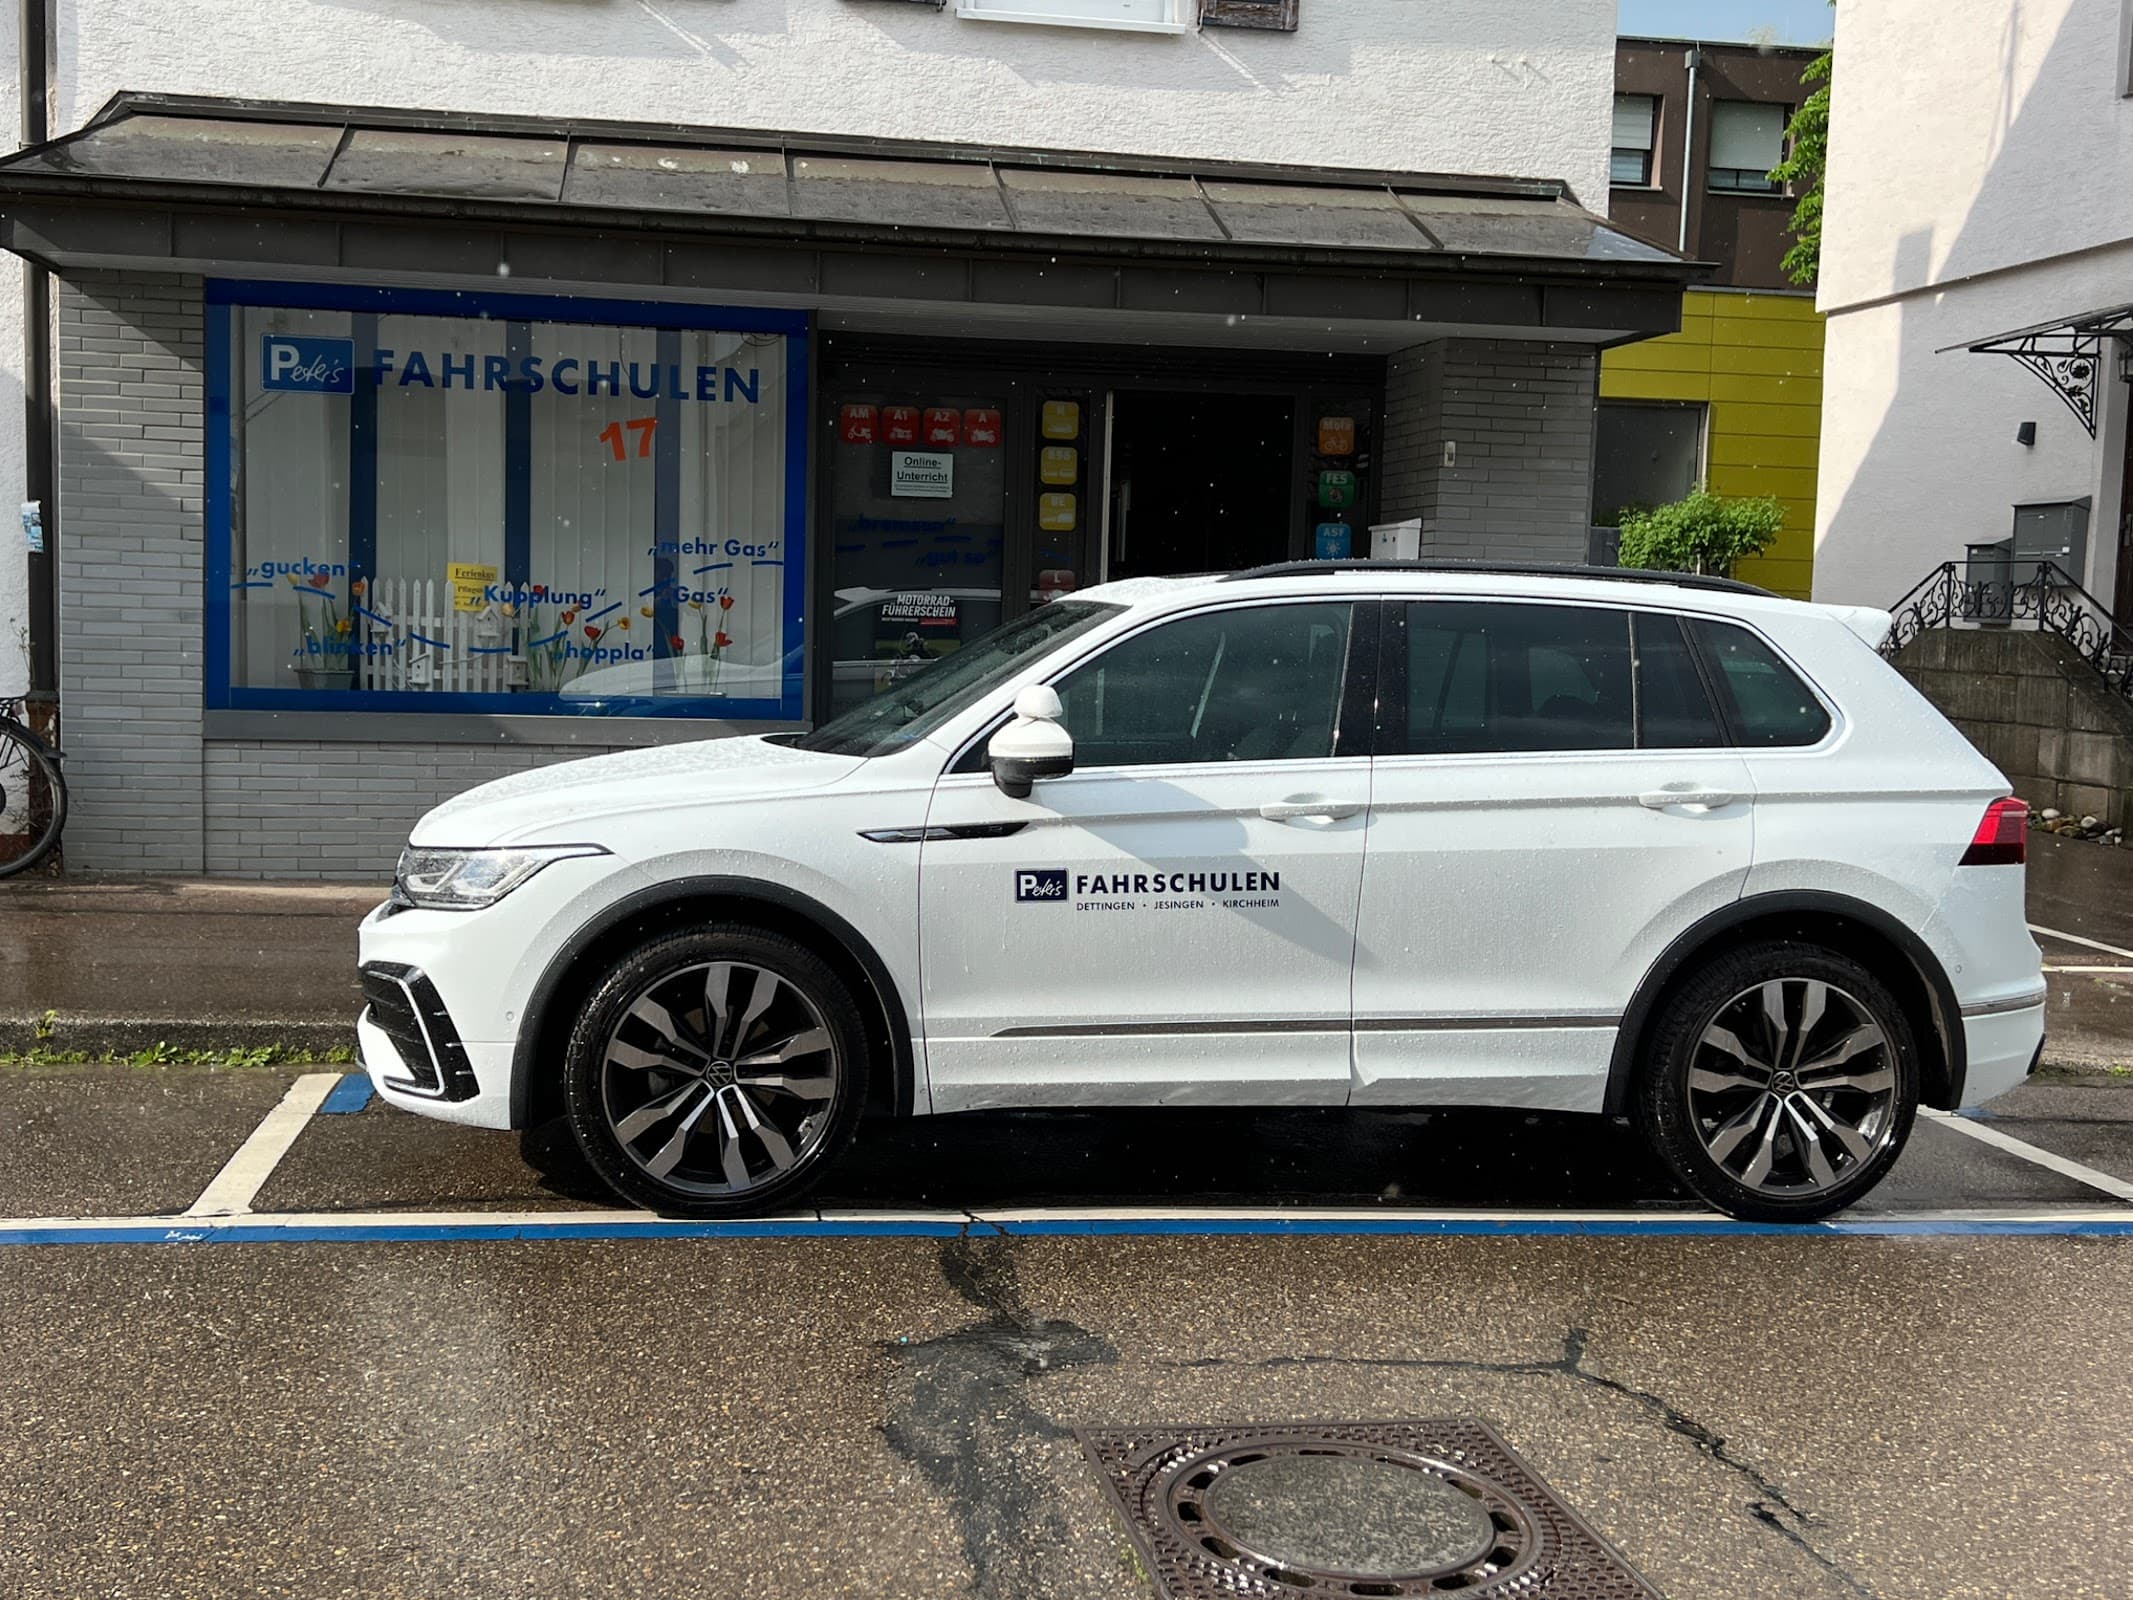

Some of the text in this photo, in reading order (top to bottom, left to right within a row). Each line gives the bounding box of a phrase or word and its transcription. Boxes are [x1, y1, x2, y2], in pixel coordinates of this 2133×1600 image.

[373, 349, 760, 404] FAHRSCHULEN
[849, 407, 870, 419] AM
[893, 409, 909, 421] A1
[933, 411, 951, 422] A2
[977, 412, 988, 423] A
[599, 416, 658, 461] 17
[904, 456, 942, 467] Online-
[897, 471, 948, 481] Unterricht
[1326, 473, 1348, 484] FES
[1323, 527, 1345, 537] ASF
[896, 594, 955, 606] MOTORRAD-
[882, 603, 957, 617] FÜHRERSCHEIN
[1076, 872, 1280, 894] FAHRSCHULEN
[1076, 898, 1280, 911] DETTINGEN JESINGEN KIRCHHEIM
